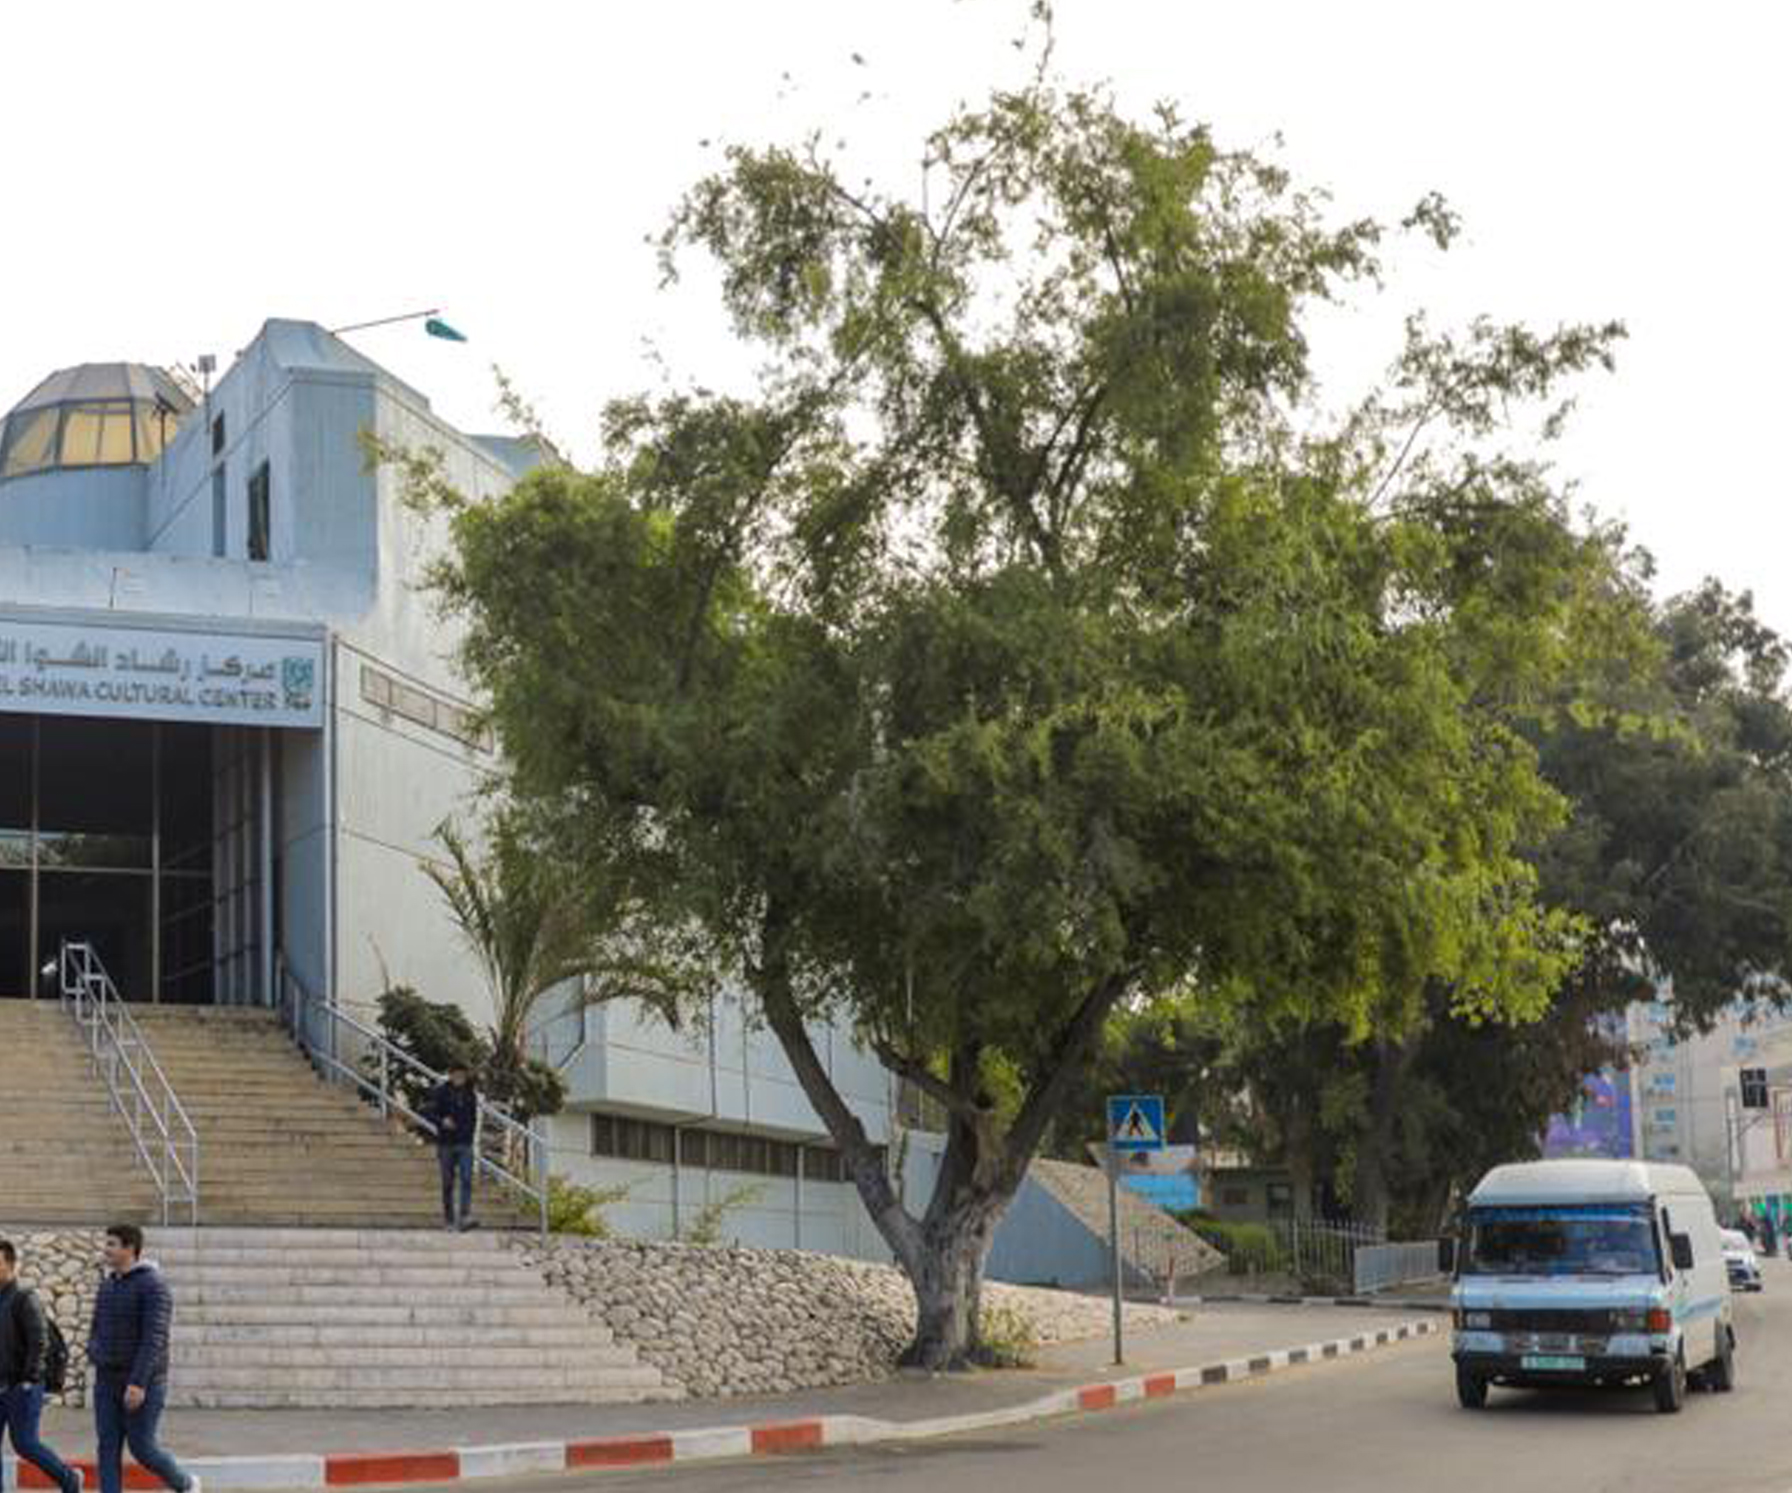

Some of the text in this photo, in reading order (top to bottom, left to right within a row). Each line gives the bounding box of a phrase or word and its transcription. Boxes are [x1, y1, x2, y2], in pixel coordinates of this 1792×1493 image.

[19, 676, 92, 701] SHAWA
[95, 679, 195, 706] CULTURAL
[198, 687, 276, 710] CENTER
